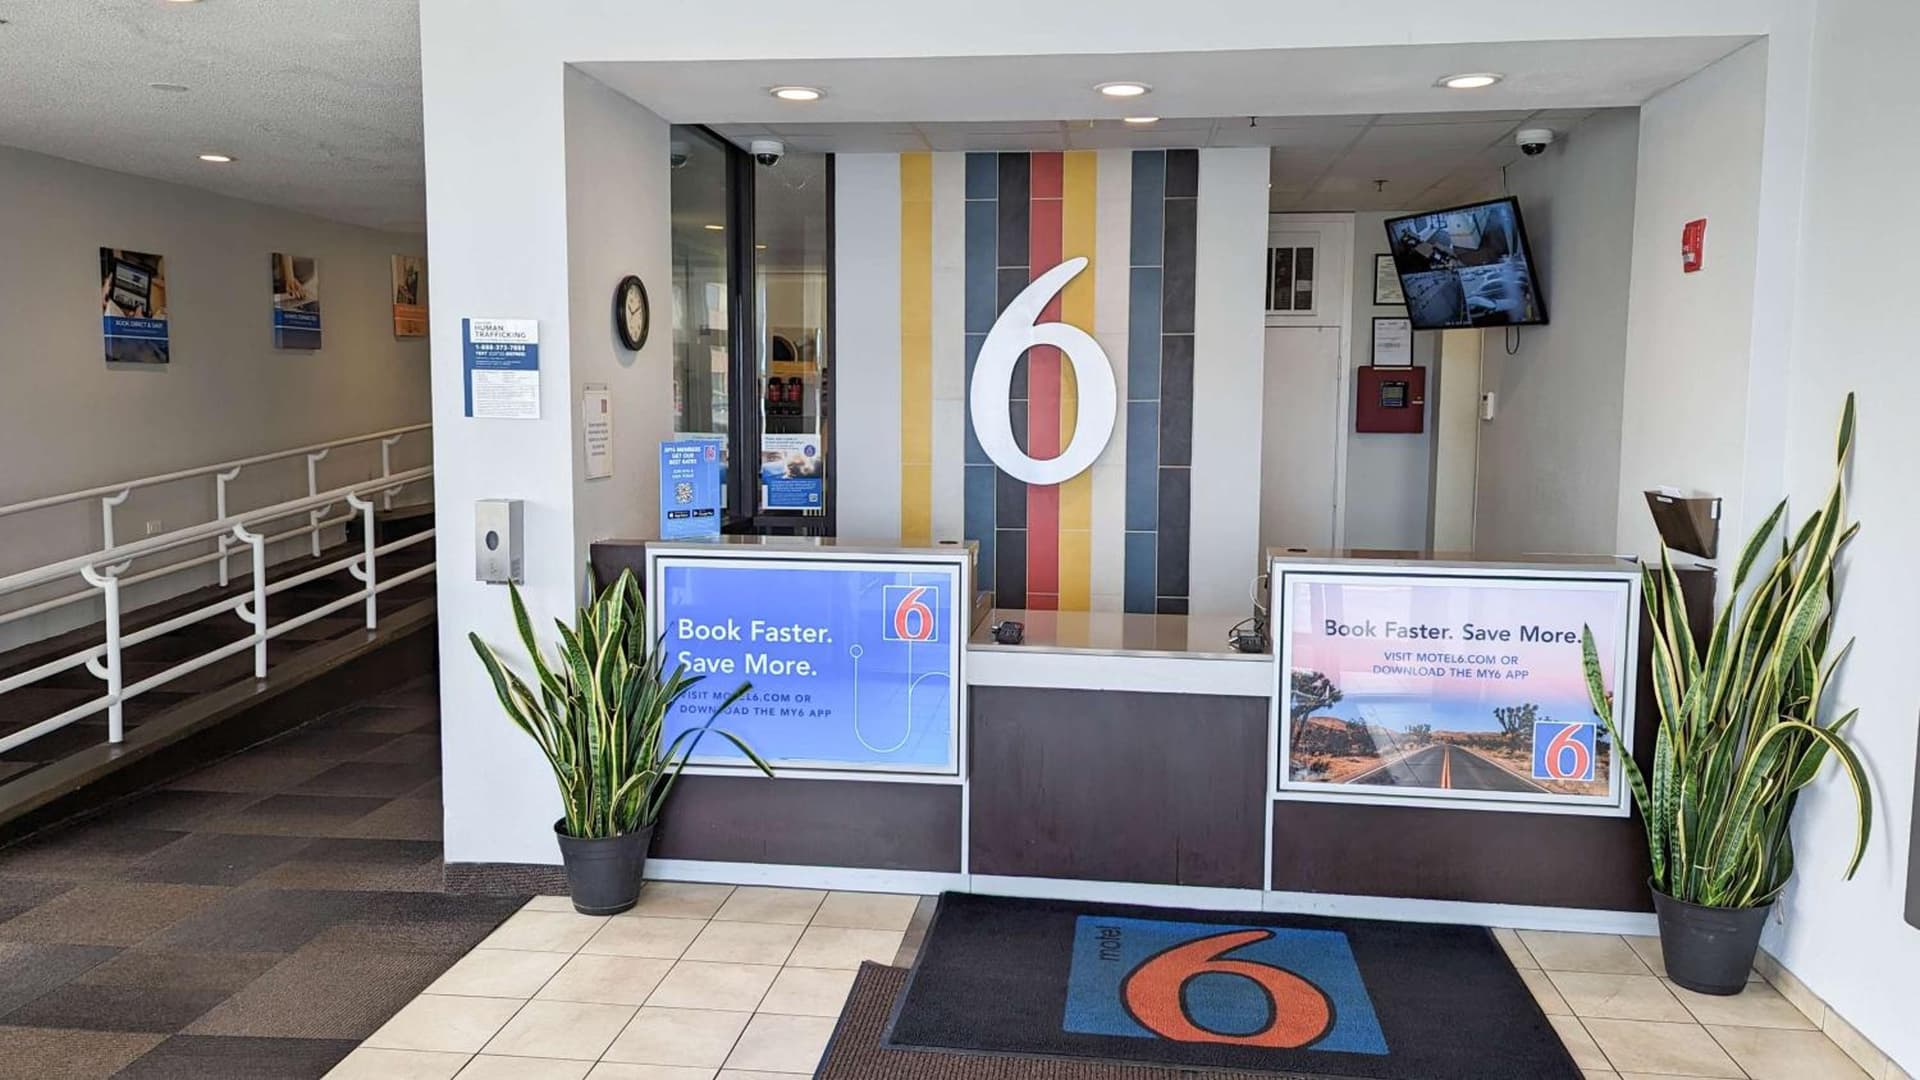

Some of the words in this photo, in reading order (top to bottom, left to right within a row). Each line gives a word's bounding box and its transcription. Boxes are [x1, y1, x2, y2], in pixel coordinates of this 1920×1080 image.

[970, 256, 1117, 485] 6
[895, 587, 934, 641] 6
[678, 618, 742, 641] Book
[751, 620, 833, 643] Faster.
[1325, 619, 1376, 637] Book
[1385, 621, 1453, 640] Faster.
[1462, 623, 1511, 641] Save
[1520, 625, 1582, 644] More.
[678, 651, 735, 673] Save
[745, 653, 817, 676] More.
[1384, 652, 1411, 661] VISIT
[1416, 652, 1496, 665] MOTEL6.COM
[1501, 655, 1518, 665] OR
[1372, 664, 1445, 677] DOWNLOAD
[1450, 668, 1472, 678] THE
[1477, 669, 1501, 679] MY6
[1505, 670, 1529, 679] APP
[795, 694, 811, 703] OR
[680, 705, 749, 716] DOWNOAD
[754, 707, 776, 716] THE
[780, 708, 804, 718] MY6
[809, 709, 832, 718] APP
[1545, 722, 1590, 780] 6
[1096, 925, 1122, 962] motel
[1119, 928, 1336, 1050] 6
